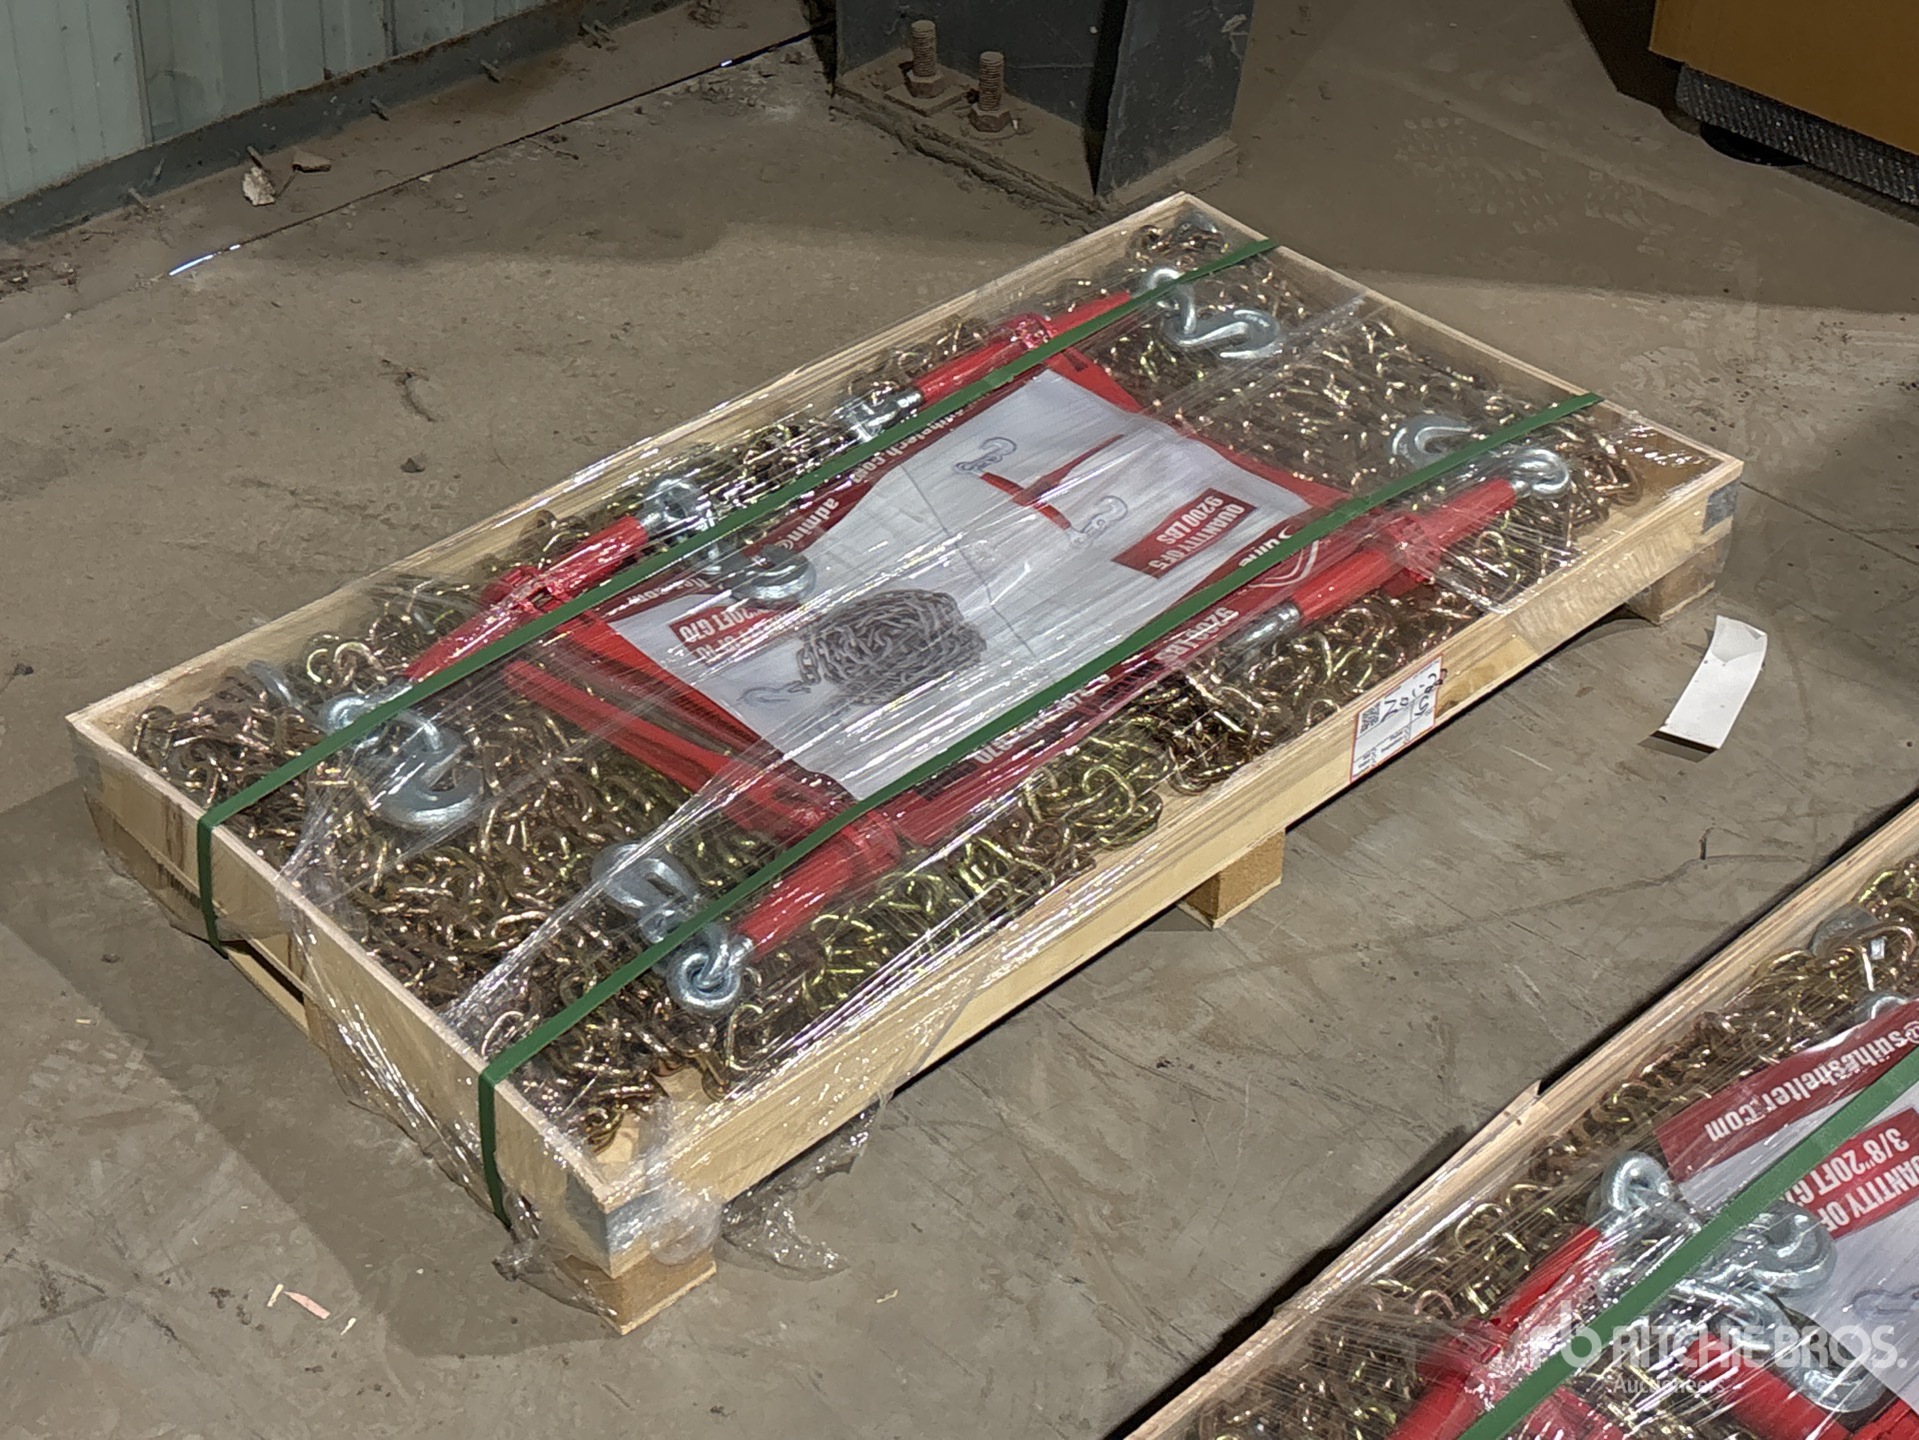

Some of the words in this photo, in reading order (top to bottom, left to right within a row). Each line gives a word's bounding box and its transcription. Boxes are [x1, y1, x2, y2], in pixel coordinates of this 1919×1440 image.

[1177, 503, 1246, 552] QUANTITY
[1181, 496, 1224, 528] 9200
[1156, 521, 1192, 545] LBS
[1148, 559, 1171, 571] 5
[1160, 549, 1185, 564] OF
[1849, 1154, 1919, 1219] UANTITY
[1817, 1200, 1850, 1233] OF
